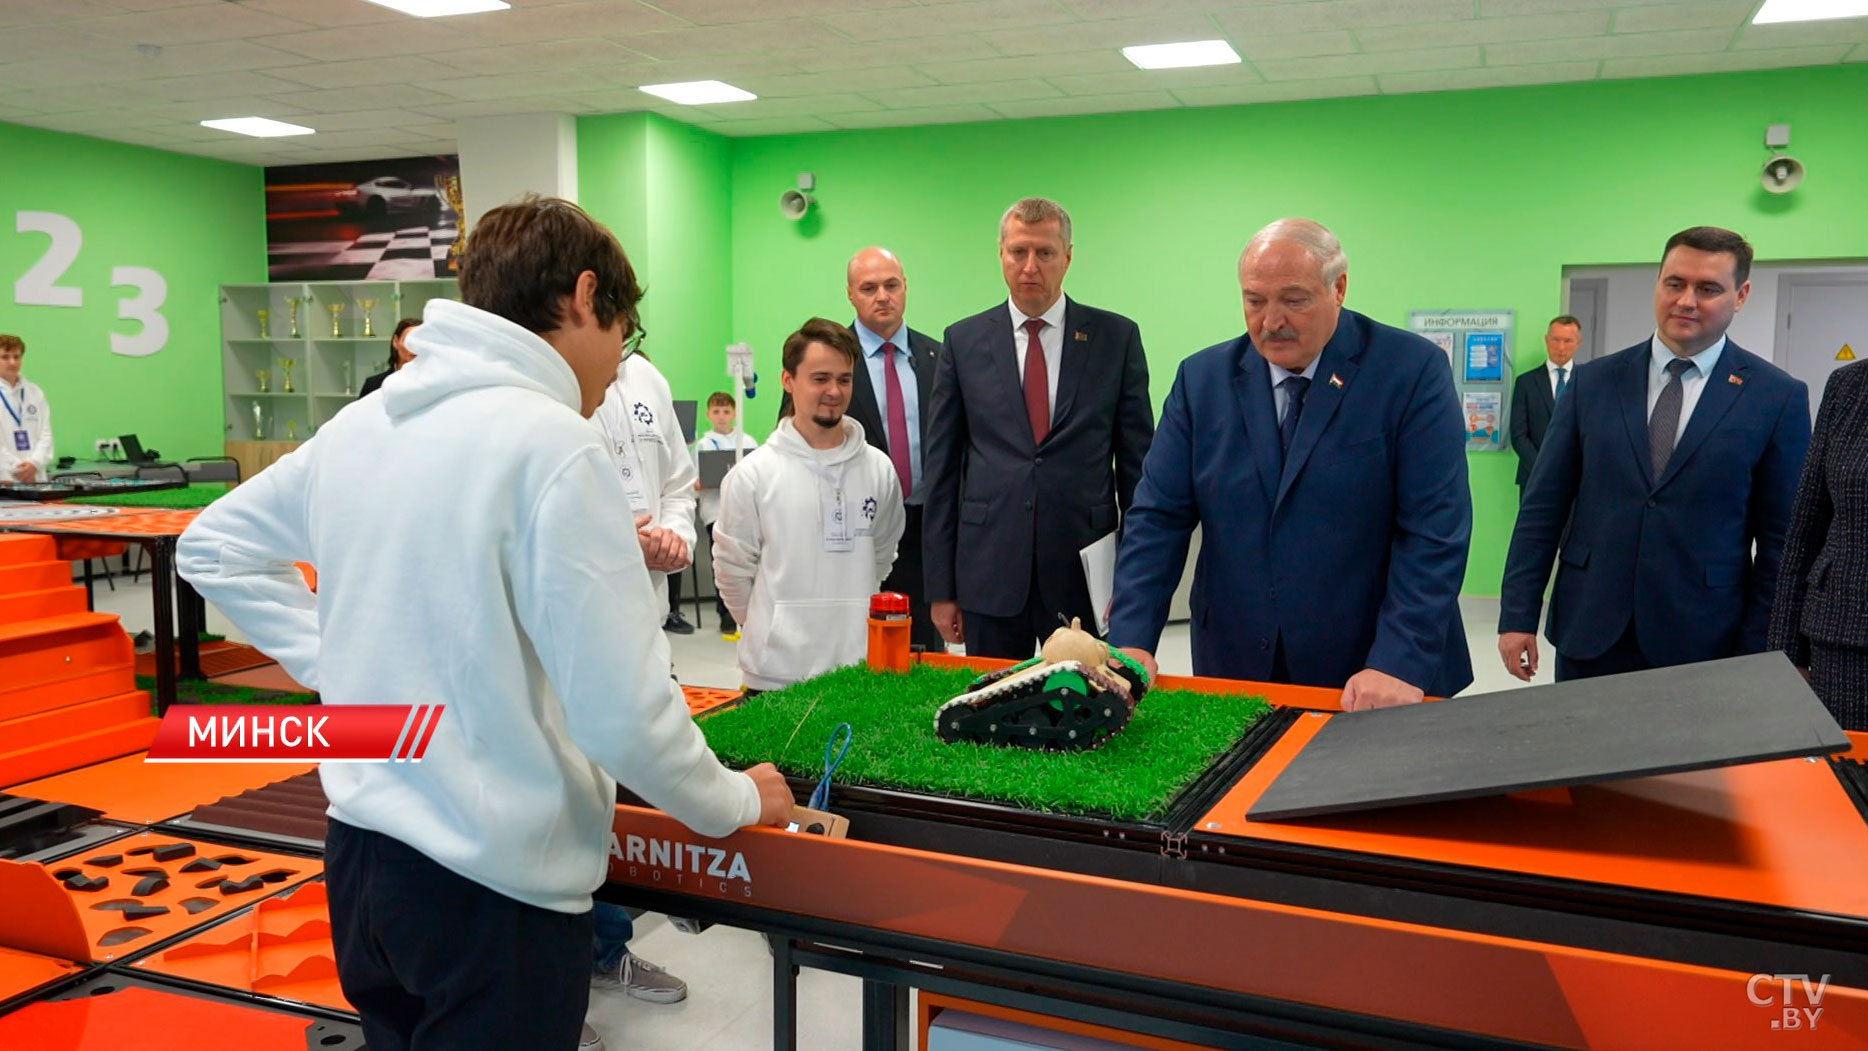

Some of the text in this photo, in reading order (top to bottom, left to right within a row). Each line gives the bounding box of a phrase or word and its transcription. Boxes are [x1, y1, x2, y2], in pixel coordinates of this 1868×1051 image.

[14, 210, 83, 307] 2
[109, 266, 169, 357] 3
[1424, 317, 1498, 328] ИНФОРМАЦИЯ
